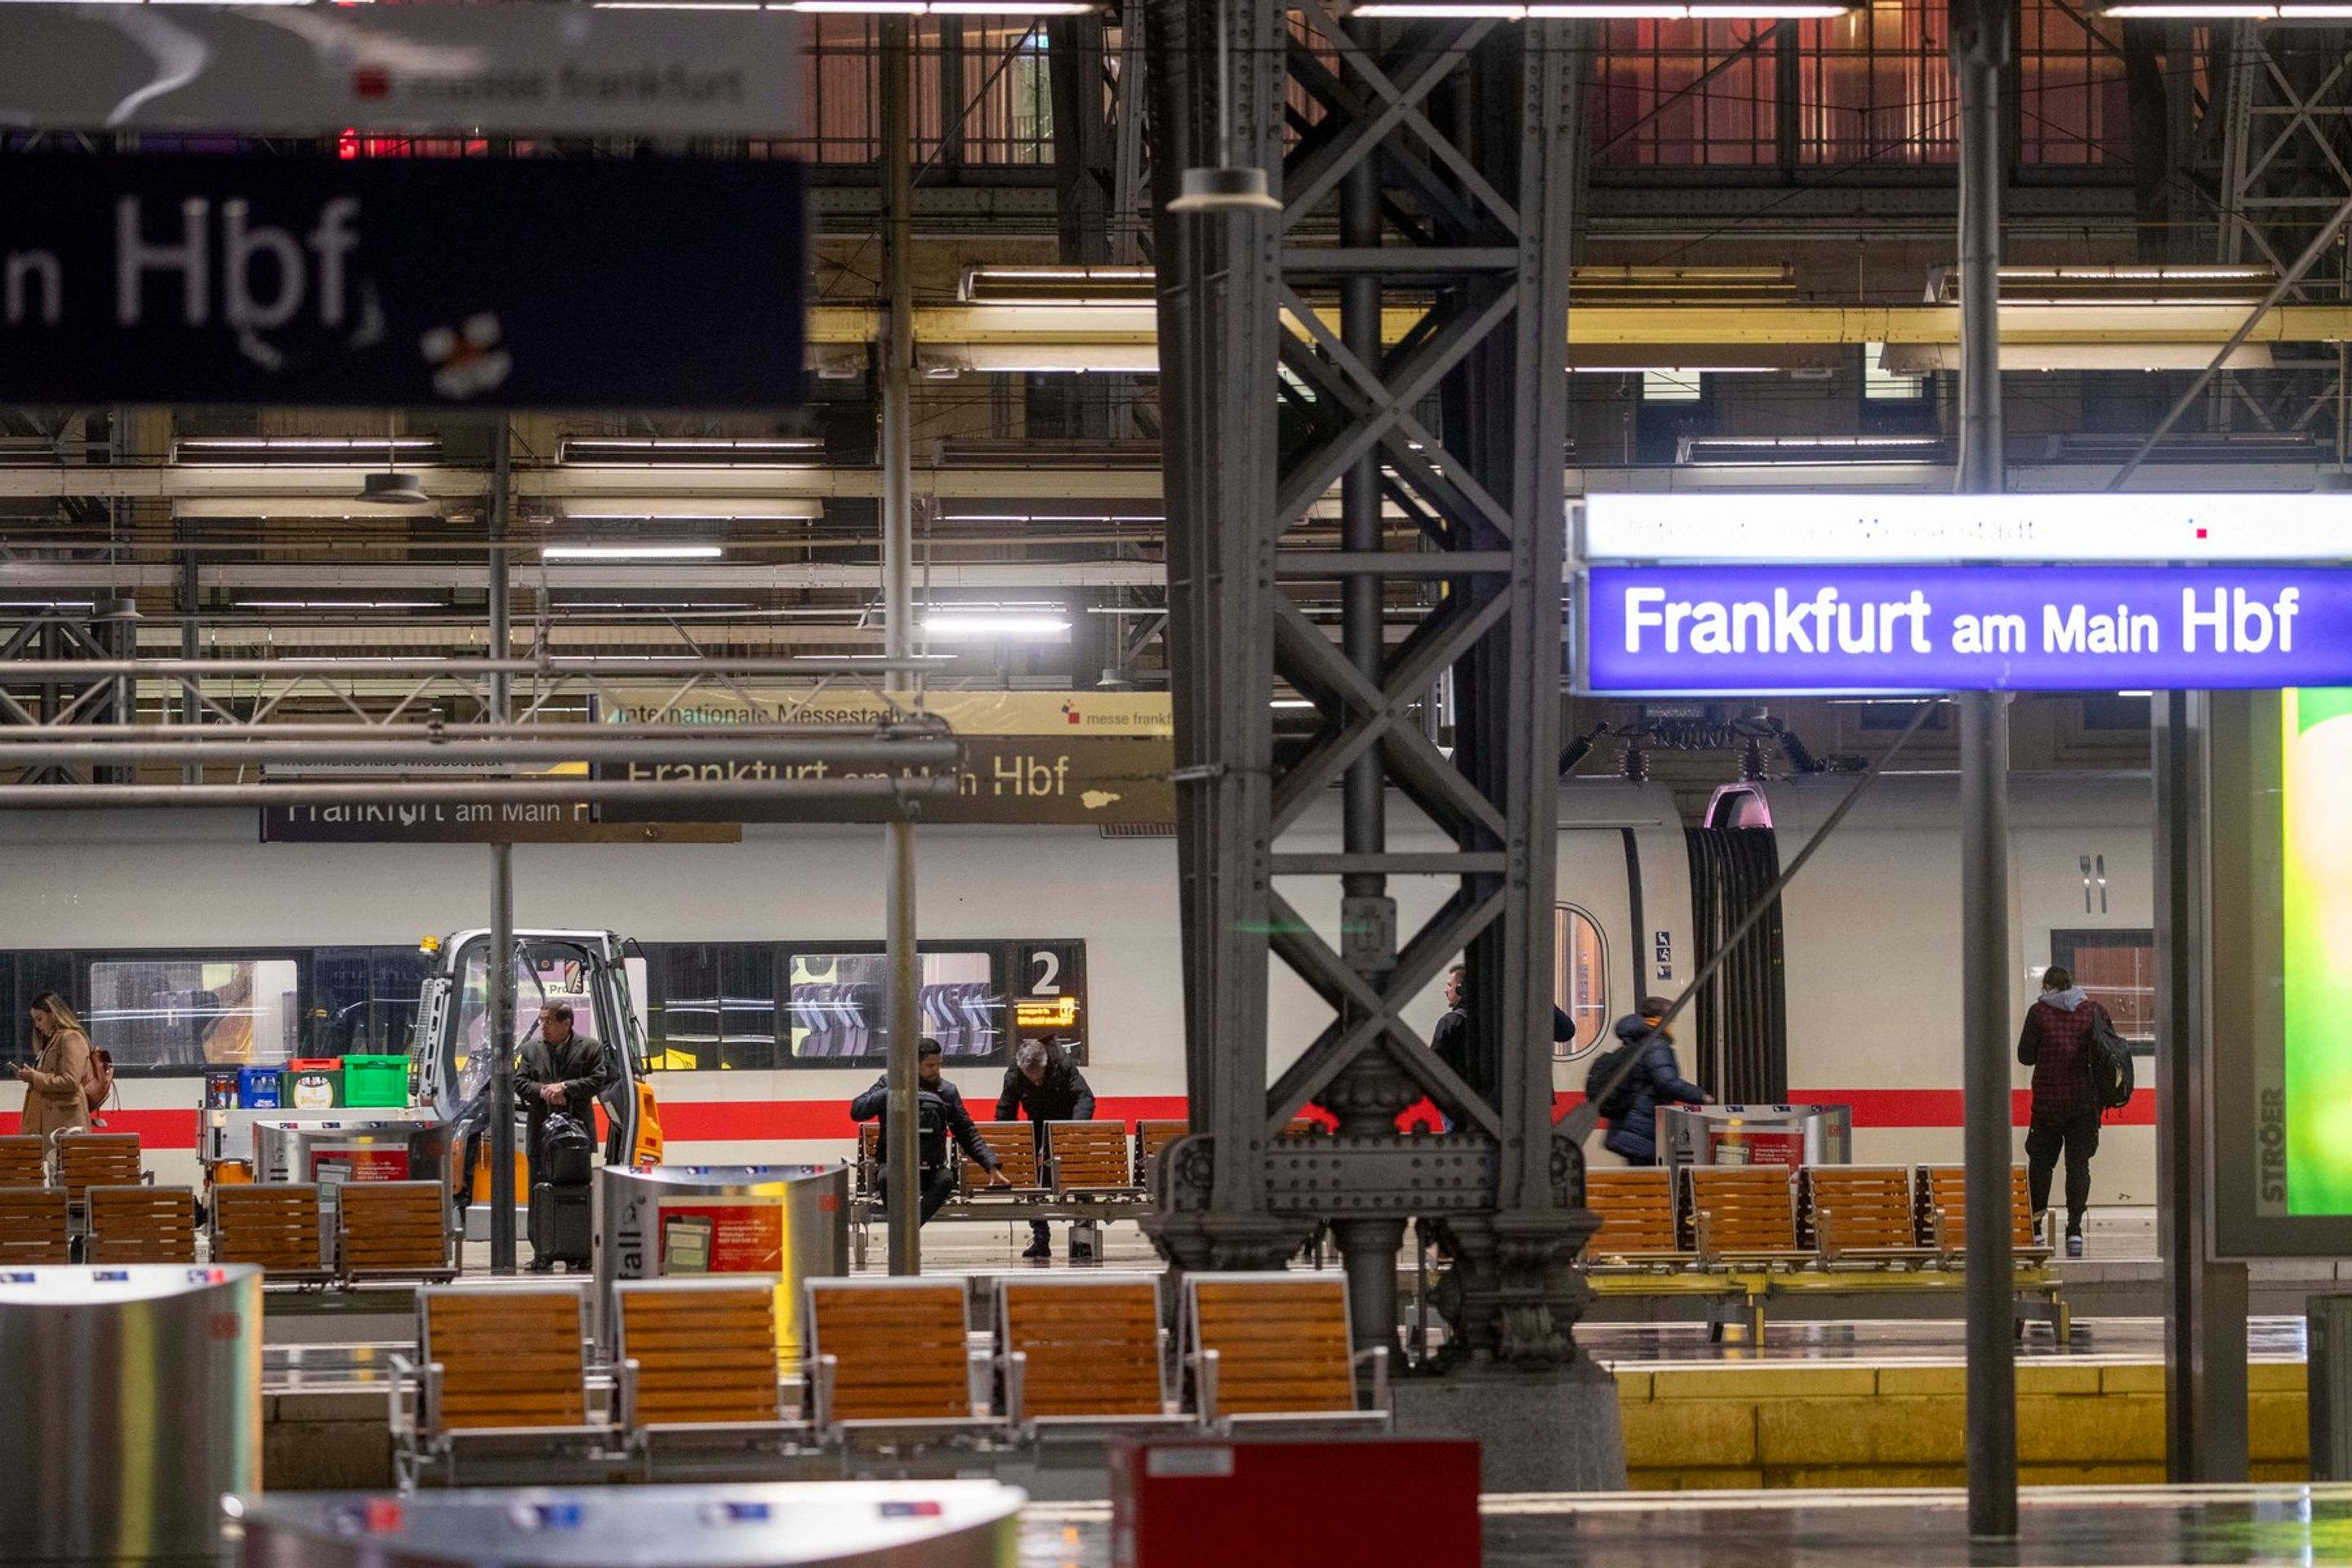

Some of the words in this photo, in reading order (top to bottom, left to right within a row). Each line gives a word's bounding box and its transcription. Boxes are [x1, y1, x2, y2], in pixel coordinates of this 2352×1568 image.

[116, 194, 361, 327] Hbf
[1625, 586, 1931, 653] Frankfurt
[1952, 614, 2025, 653] am
[2043, 604, 2158, 653] Main
[2182, 586, 2300, 653] Hbf
[777, 703, 902, 724] Messestad
[1087, 715, 1129, 725] messe
[994, 755, 1069, 796] Hbf
[456, 804, 492, 822] am
[1032, 951, 1060, 995] 2
[2259, 1087, 2285, 1203] STRÖER
